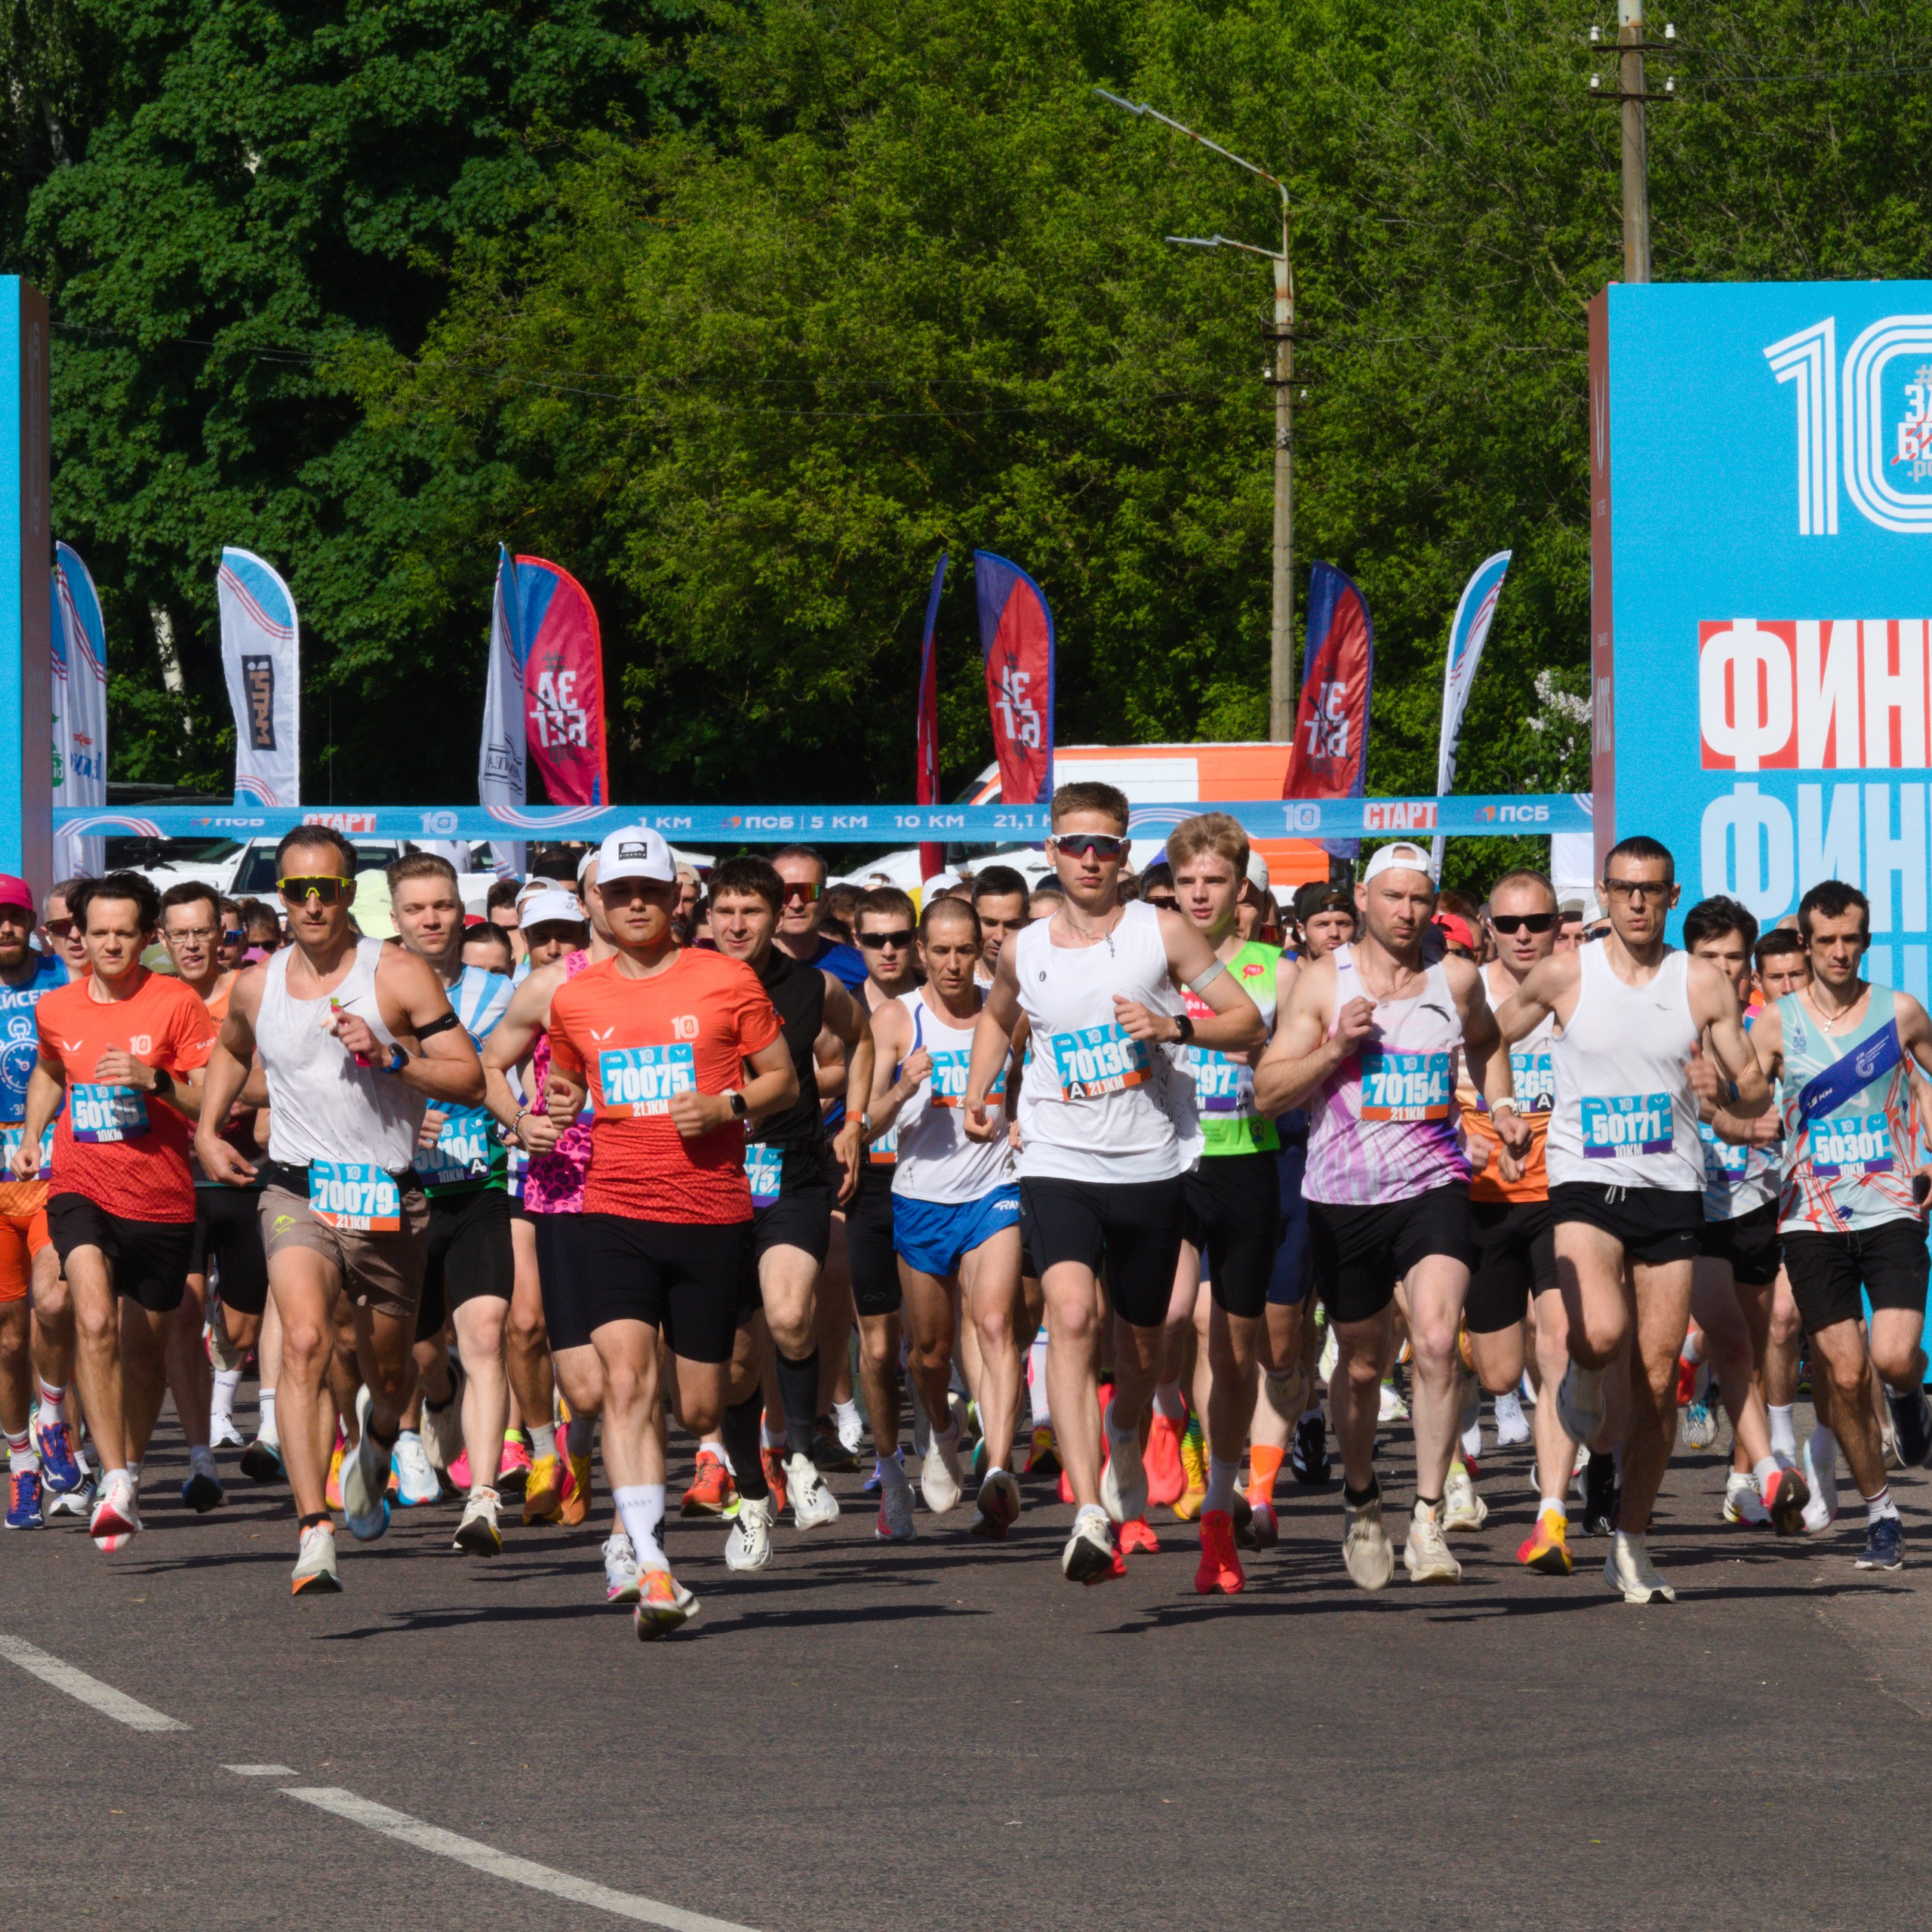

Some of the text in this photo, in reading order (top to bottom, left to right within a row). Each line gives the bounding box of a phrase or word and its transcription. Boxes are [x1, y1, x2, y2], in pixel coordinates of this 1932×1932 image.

[1905, 385, 1932, 423] З
[1700, 619, 1932, 772] ФИН
[746, 816, 794, 829] ПСБ
[811, 816, 824, 829] 5
[894, 815, 921, 829] 10
[1364, 801, 1437, 830] СТАРТ
[1500, 805, 1549, 822] ПСБ
[671, 1014, 700, 1040] 10
[129, 1035, 152, 1055] 10
[607, 1062, 691, 1103] 70075
[1069, 1081, 1086, 1100] A
[1371, 1071, 1443, 1105] 70154
[1537, 1094, 1552, 1109] A
[1592, 1110, 1662, 1145] 50171
[415, 1134, 481, 1171] 50104
[1815, 1130, 1884, 1164] 50301
[471, 1158, 485, 1174] A
[743, 1163, 776, 1194] 75
[315, 1178, 394, 1215] 70079
